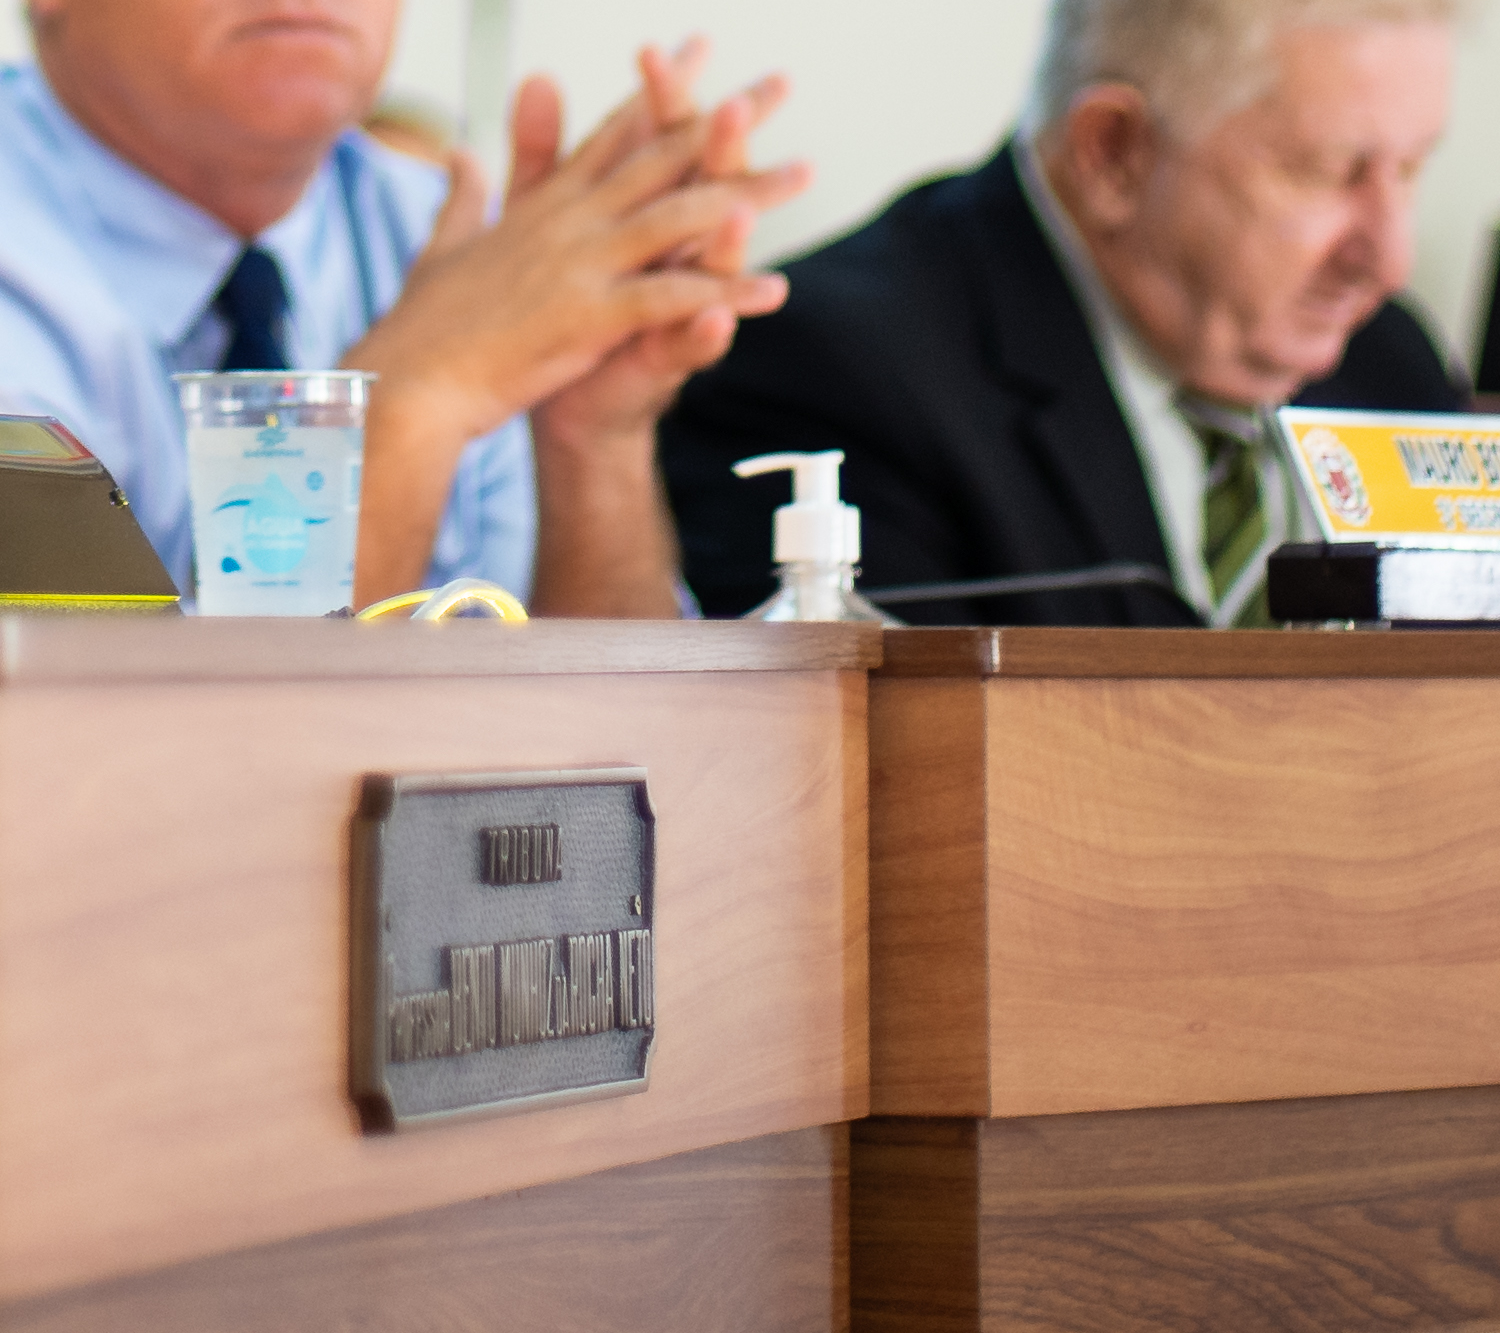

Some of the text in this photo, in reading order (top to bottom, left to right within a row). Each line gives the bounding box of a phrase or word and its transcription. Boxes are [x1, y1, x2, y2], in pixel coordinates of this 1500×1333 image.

[487, 824, 562, 882] TRIBUNA
[568, 932, 615, 1034] ROCHA
[618, 928, 652, 1029] NETO
